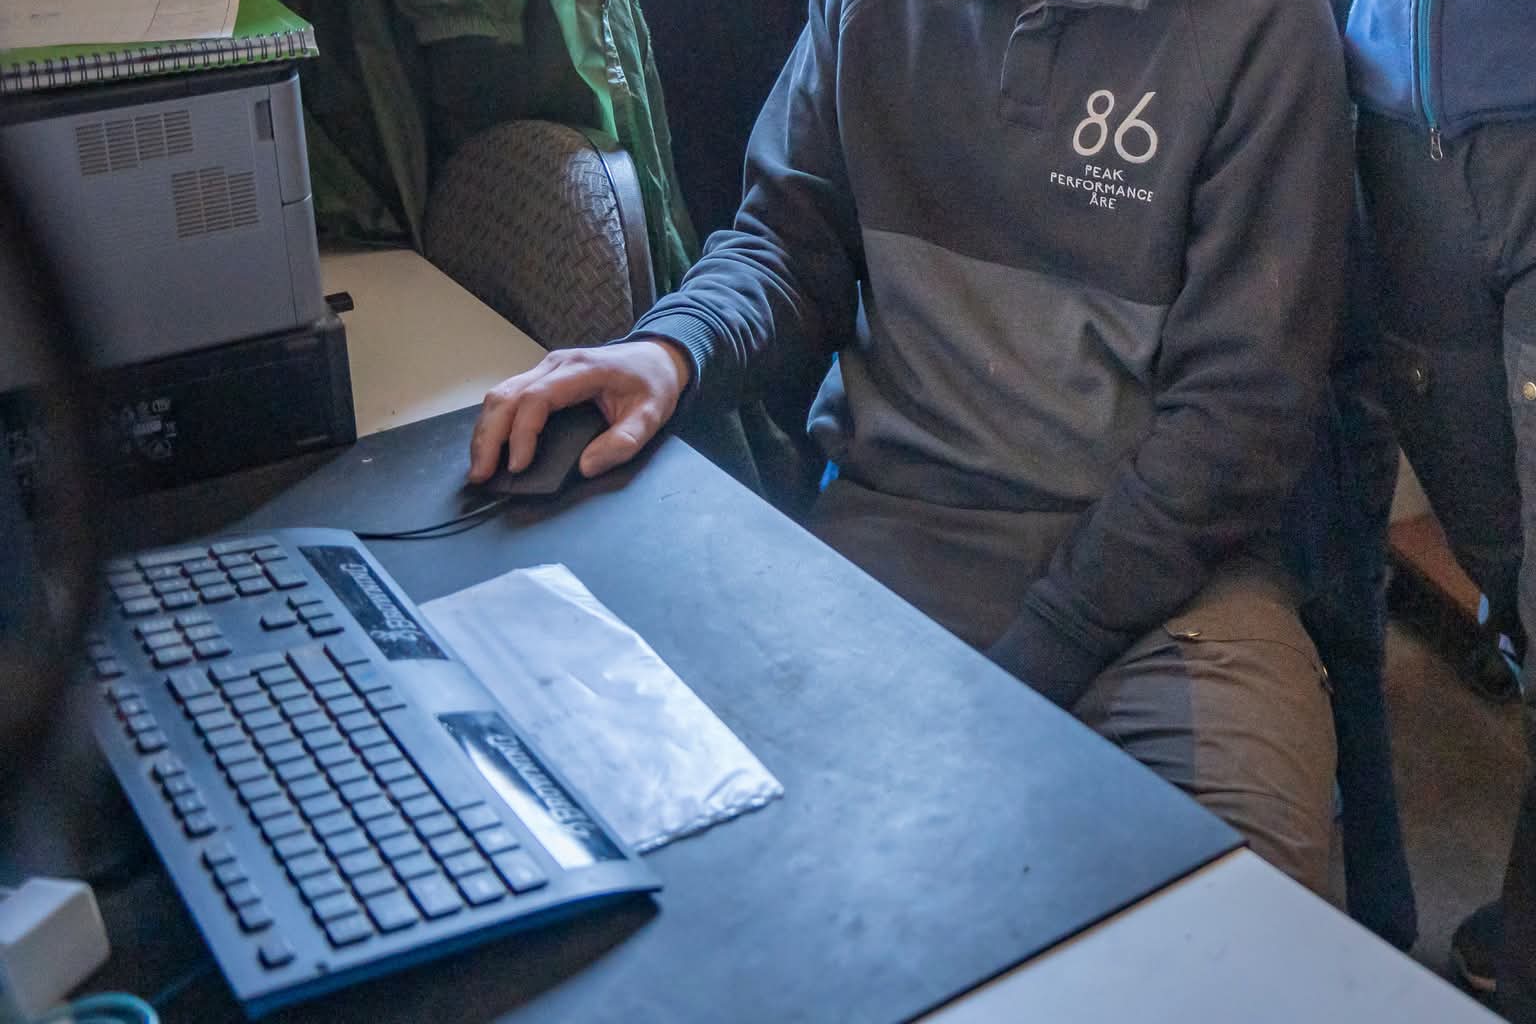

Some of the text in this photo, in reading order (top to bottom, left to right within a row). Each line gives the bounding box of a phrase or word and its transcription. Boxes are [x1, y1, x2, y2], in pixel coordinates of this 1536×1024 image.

[1073, 89, 1158, 164] 86
[1050, 172, 1154, 202] PERFORMANCE
[1085, 164, 1124, 181] PEAK
[1089, 192, 1117, 209] ÅRE
[339, 562, 418, 630] BROWNING
